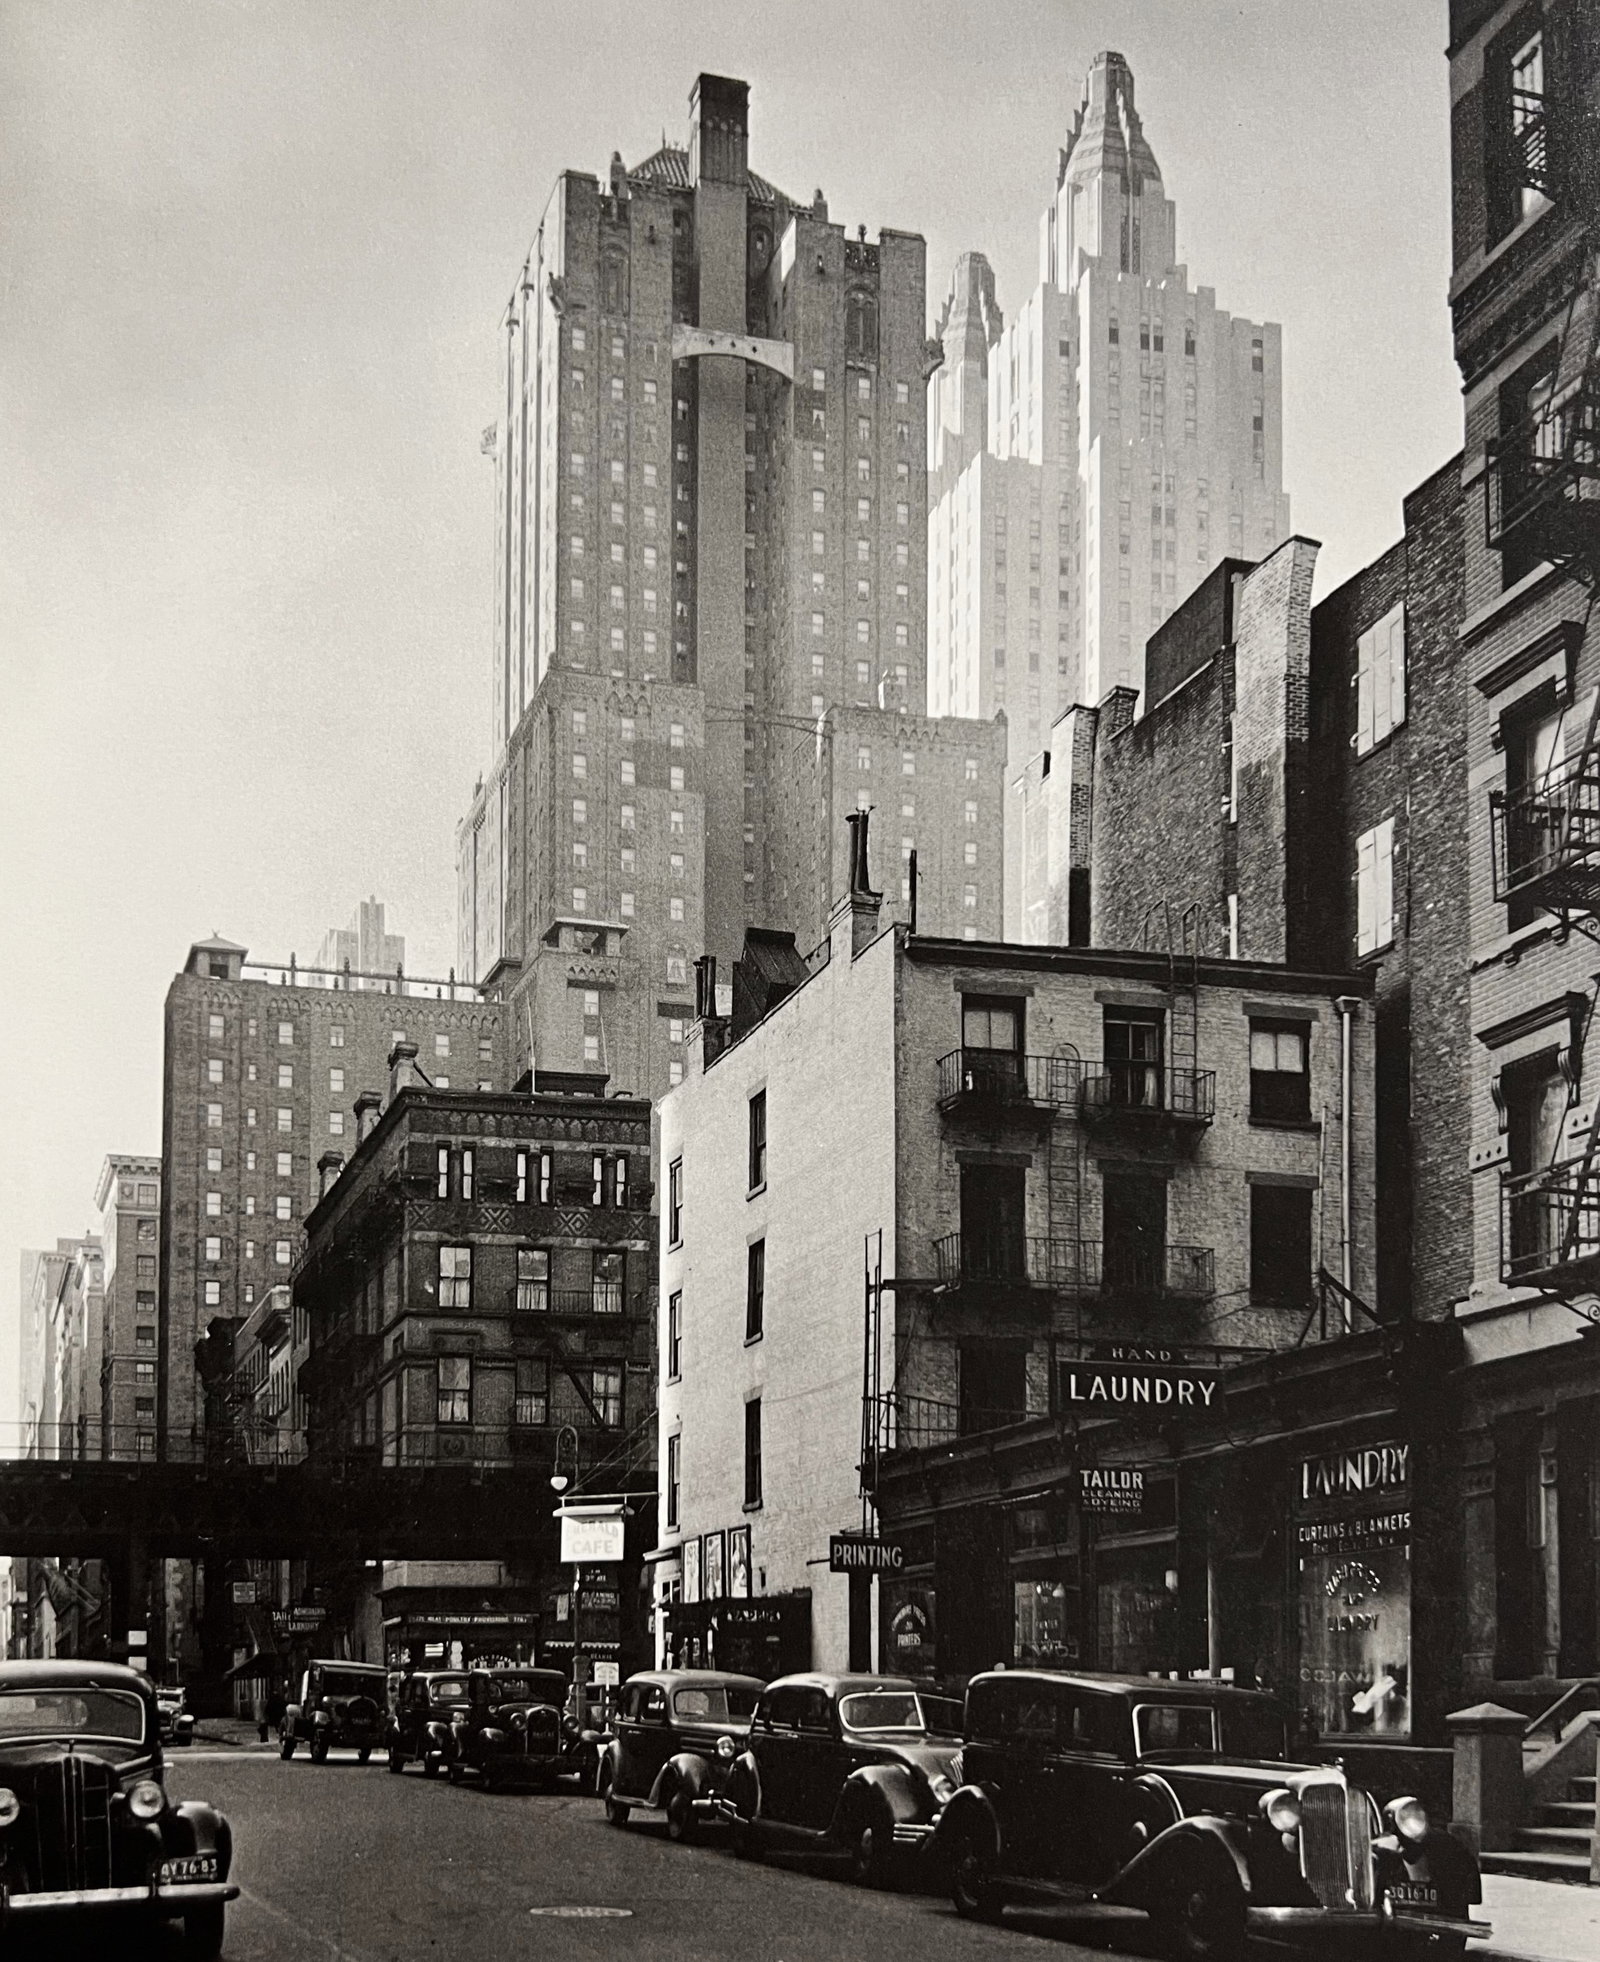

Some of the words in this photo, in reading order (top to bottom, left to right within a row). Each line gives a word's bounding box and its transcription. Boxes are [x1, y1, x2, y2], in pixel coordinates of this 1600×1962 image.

[1112, 1347, 1171, 1362] HAND
[1070, 1374, 1216, 1406] LAUNDRY
[1079, 1469, 1144, 1490] TAILOR
[1302, 1444, 1409, 1500] LAUNDRY
[1081, 1489, 1143, 1500] CLEANING
[1091, 1498, 1141, 1508] DYEING
[1299, 1522, 1345, 1542] CURTAINS
[1355, 1512, 1411, 1536] BLANKETS
[572, 1540, 614, 1554] CAFE
[833, 1544, 903, 1568] PRINTING
